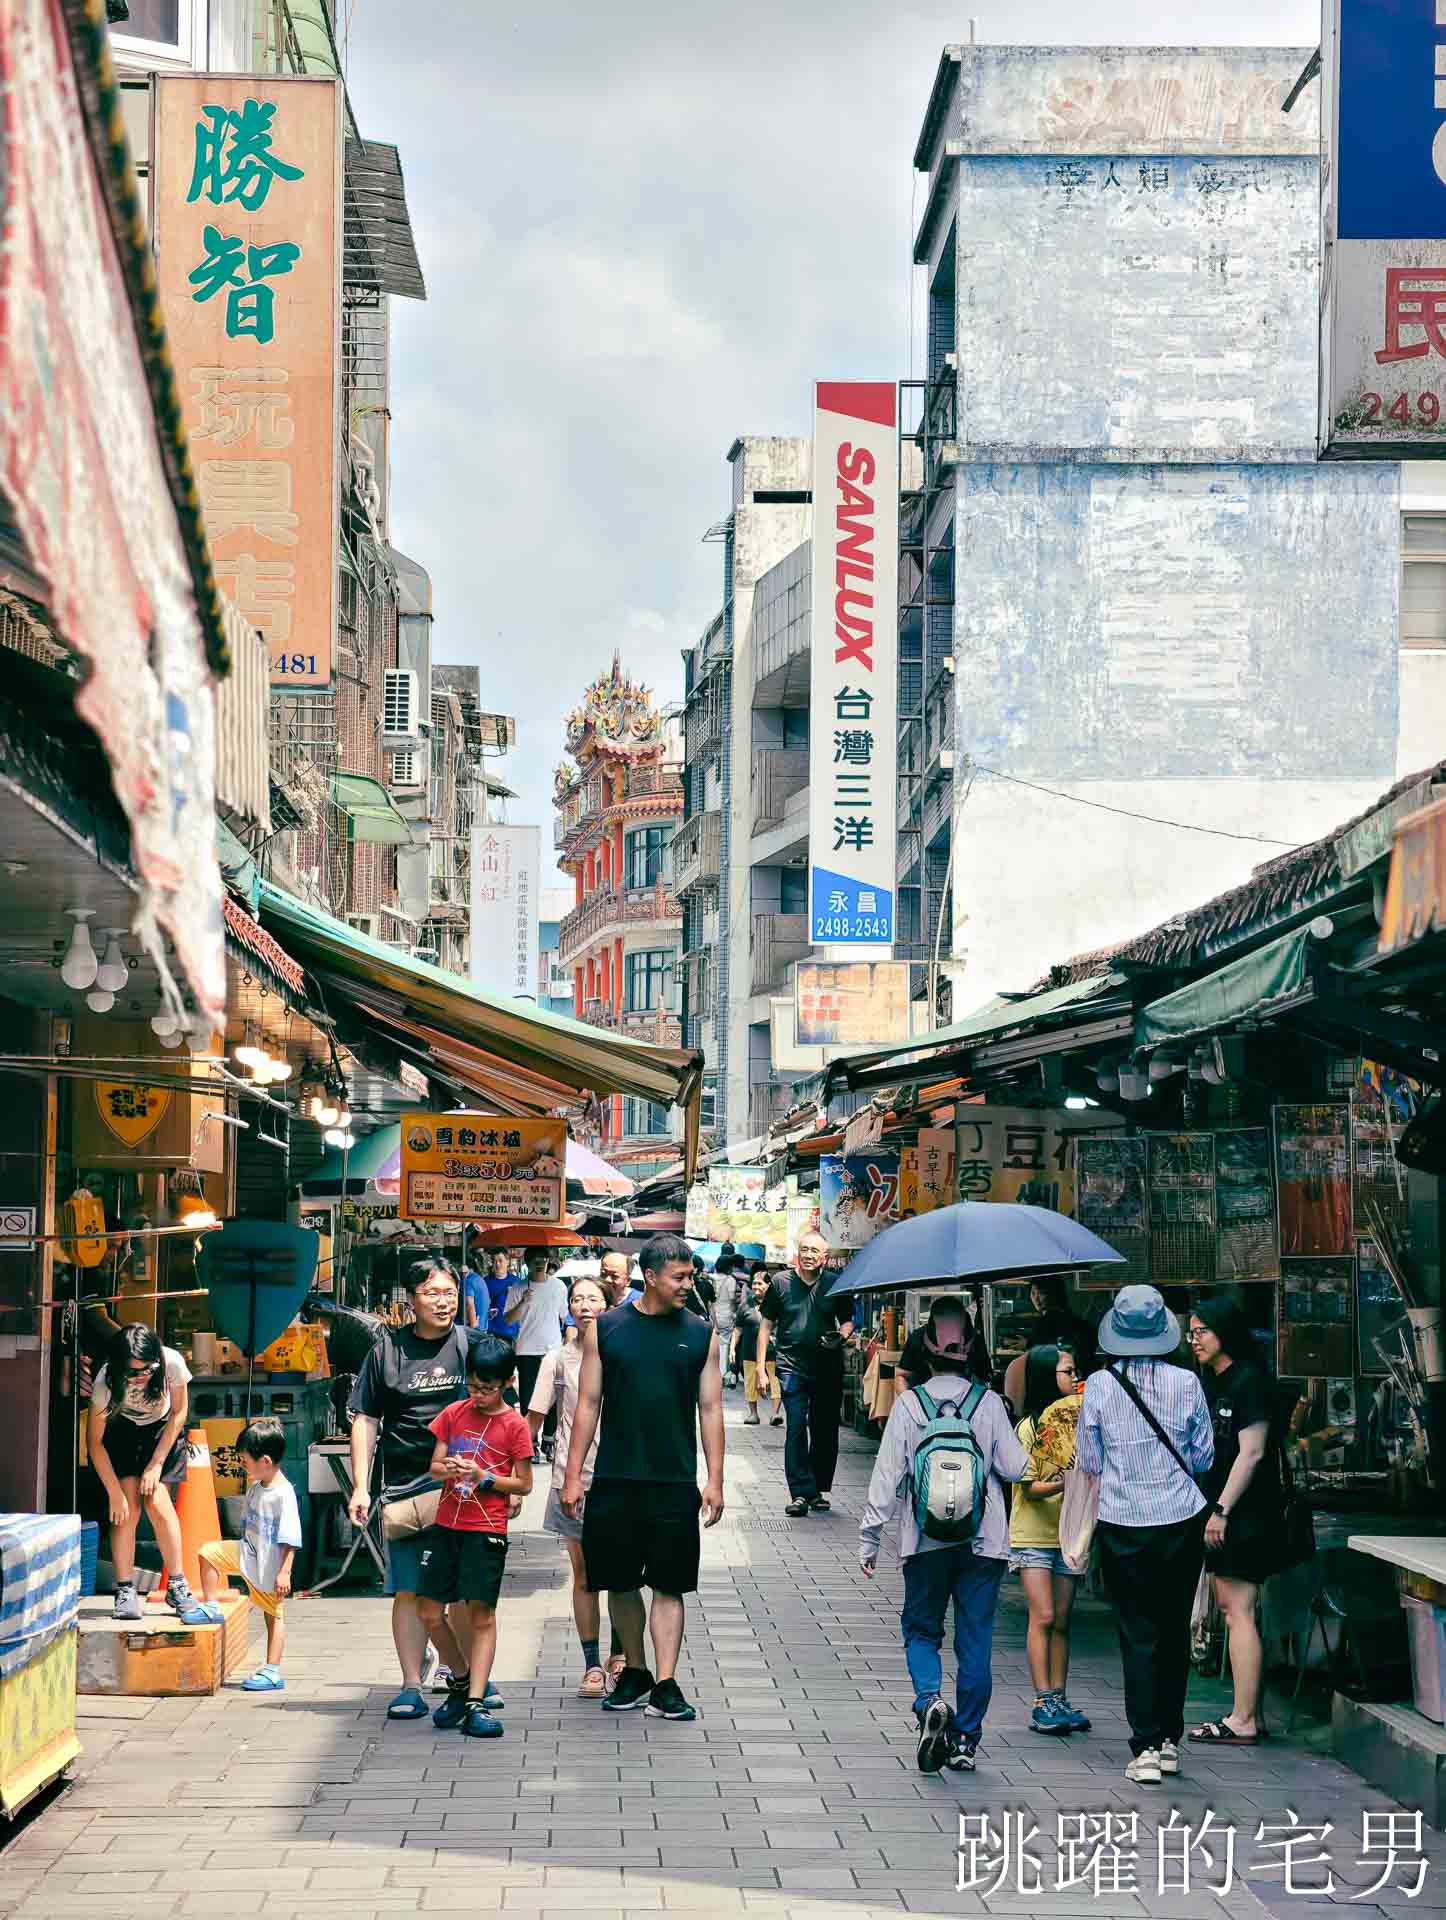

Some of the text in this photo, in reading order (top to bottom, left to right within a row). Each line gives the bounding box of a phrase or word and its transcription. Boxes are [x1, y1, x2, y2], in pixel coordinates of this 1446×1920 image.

[185, 97, 305, 344] 勝智
[834, 441, 876, 673] SANLUX
[833, 685, 874, 852] 台灣三洋
[816, 917, 888, 938] 2498-2543
[828, 890, 877, 913] 永昌
[923, 1146, 942, 1193] 古早味
